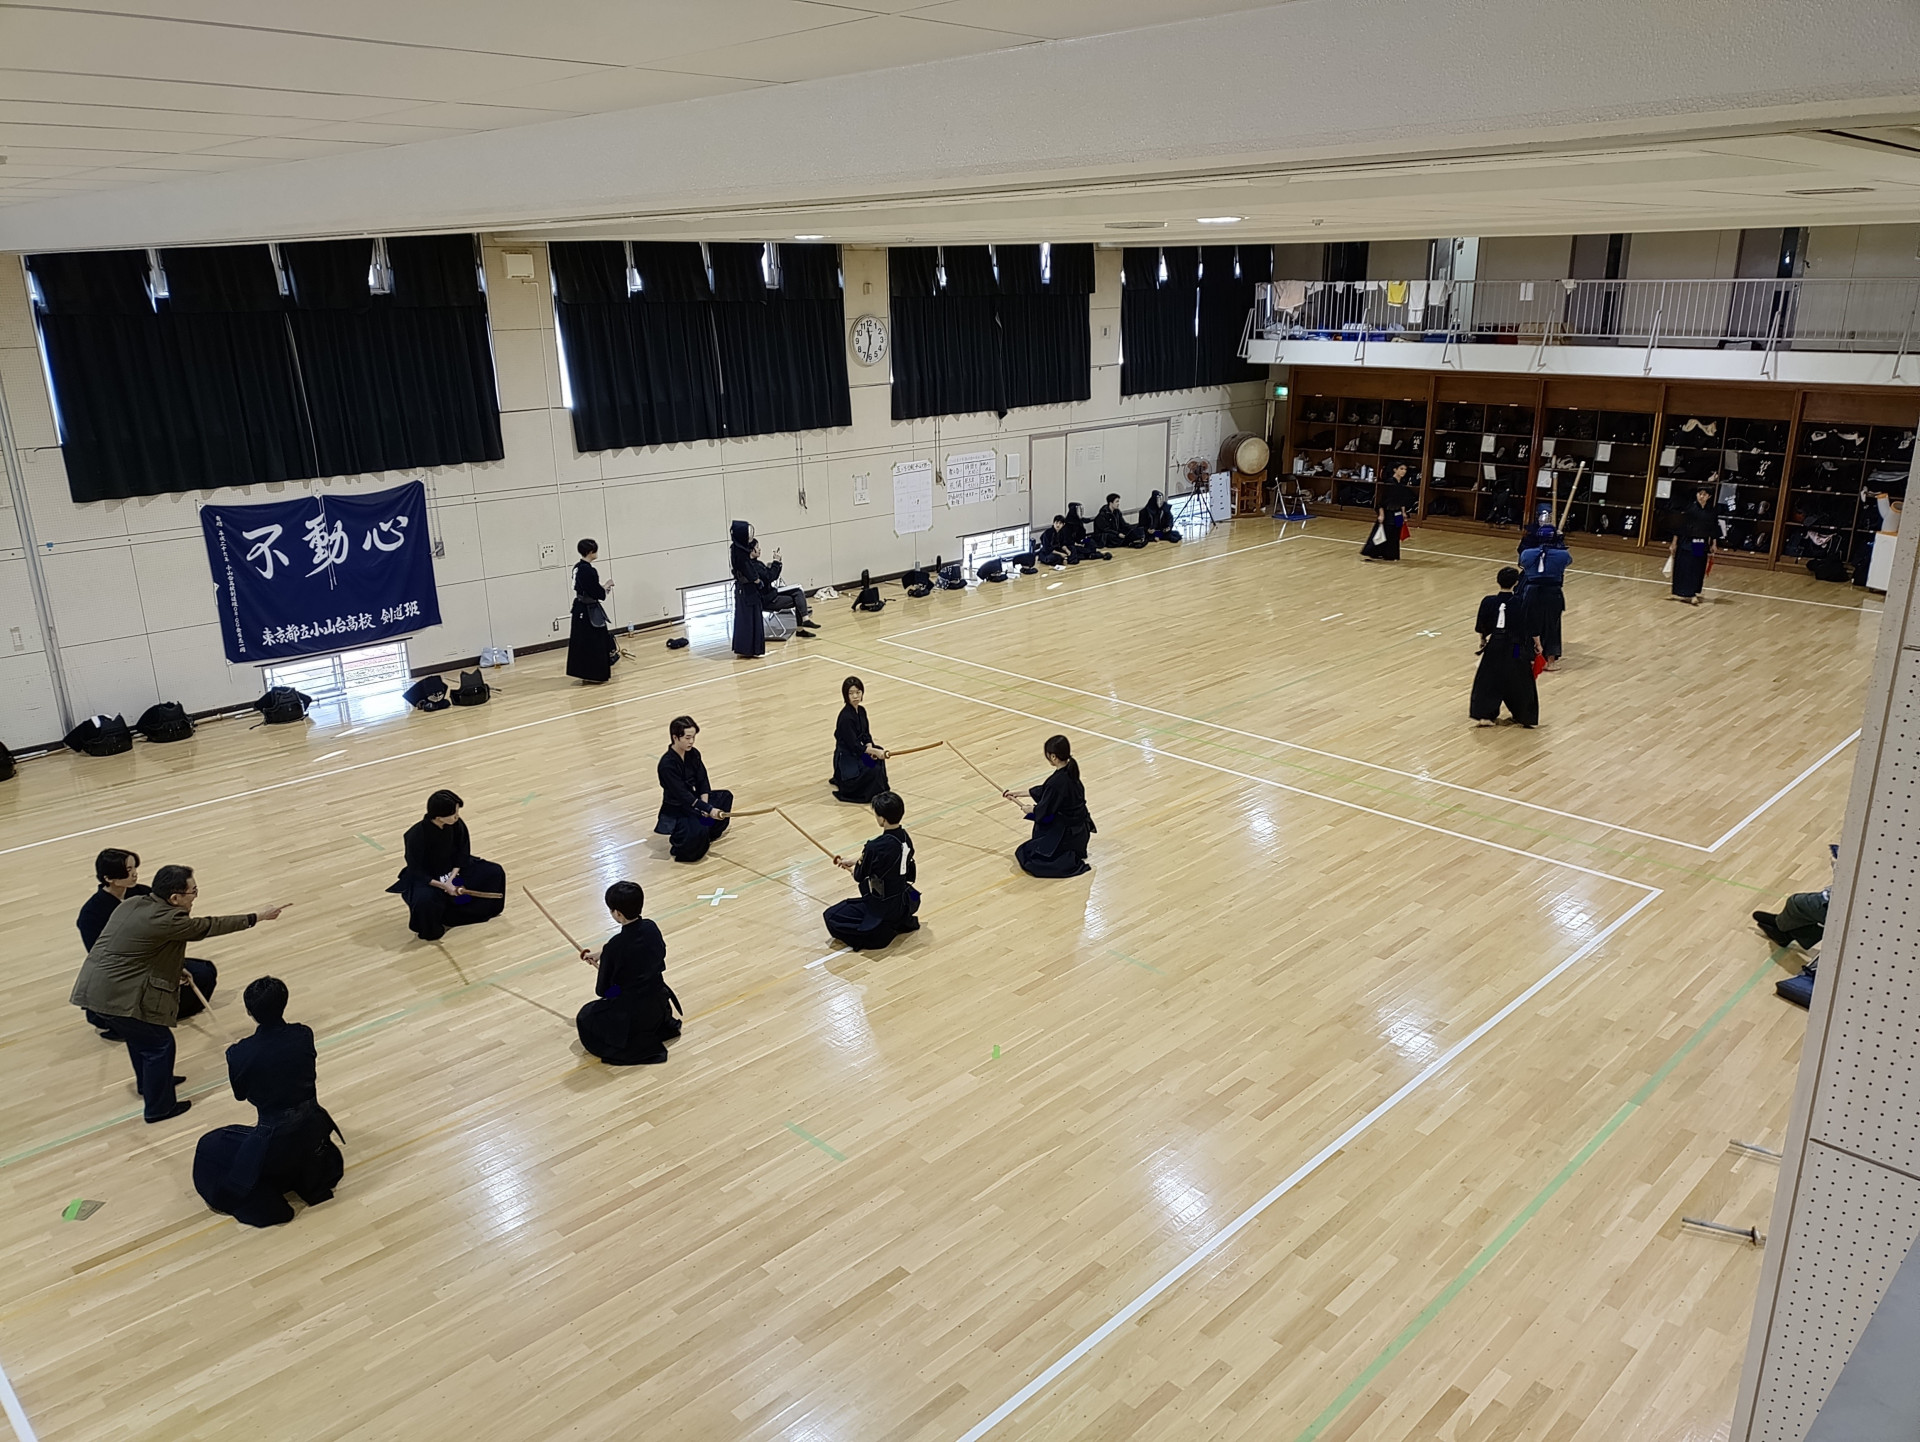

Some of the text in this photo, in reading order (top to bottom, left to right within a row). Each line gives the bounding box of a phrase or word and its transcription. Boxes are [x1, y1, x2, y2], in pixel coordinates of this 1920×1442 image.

[242, 513, 409, 579] 不動心
[262, 600, 420, 646] 東京都立小山台高校 剣道班
